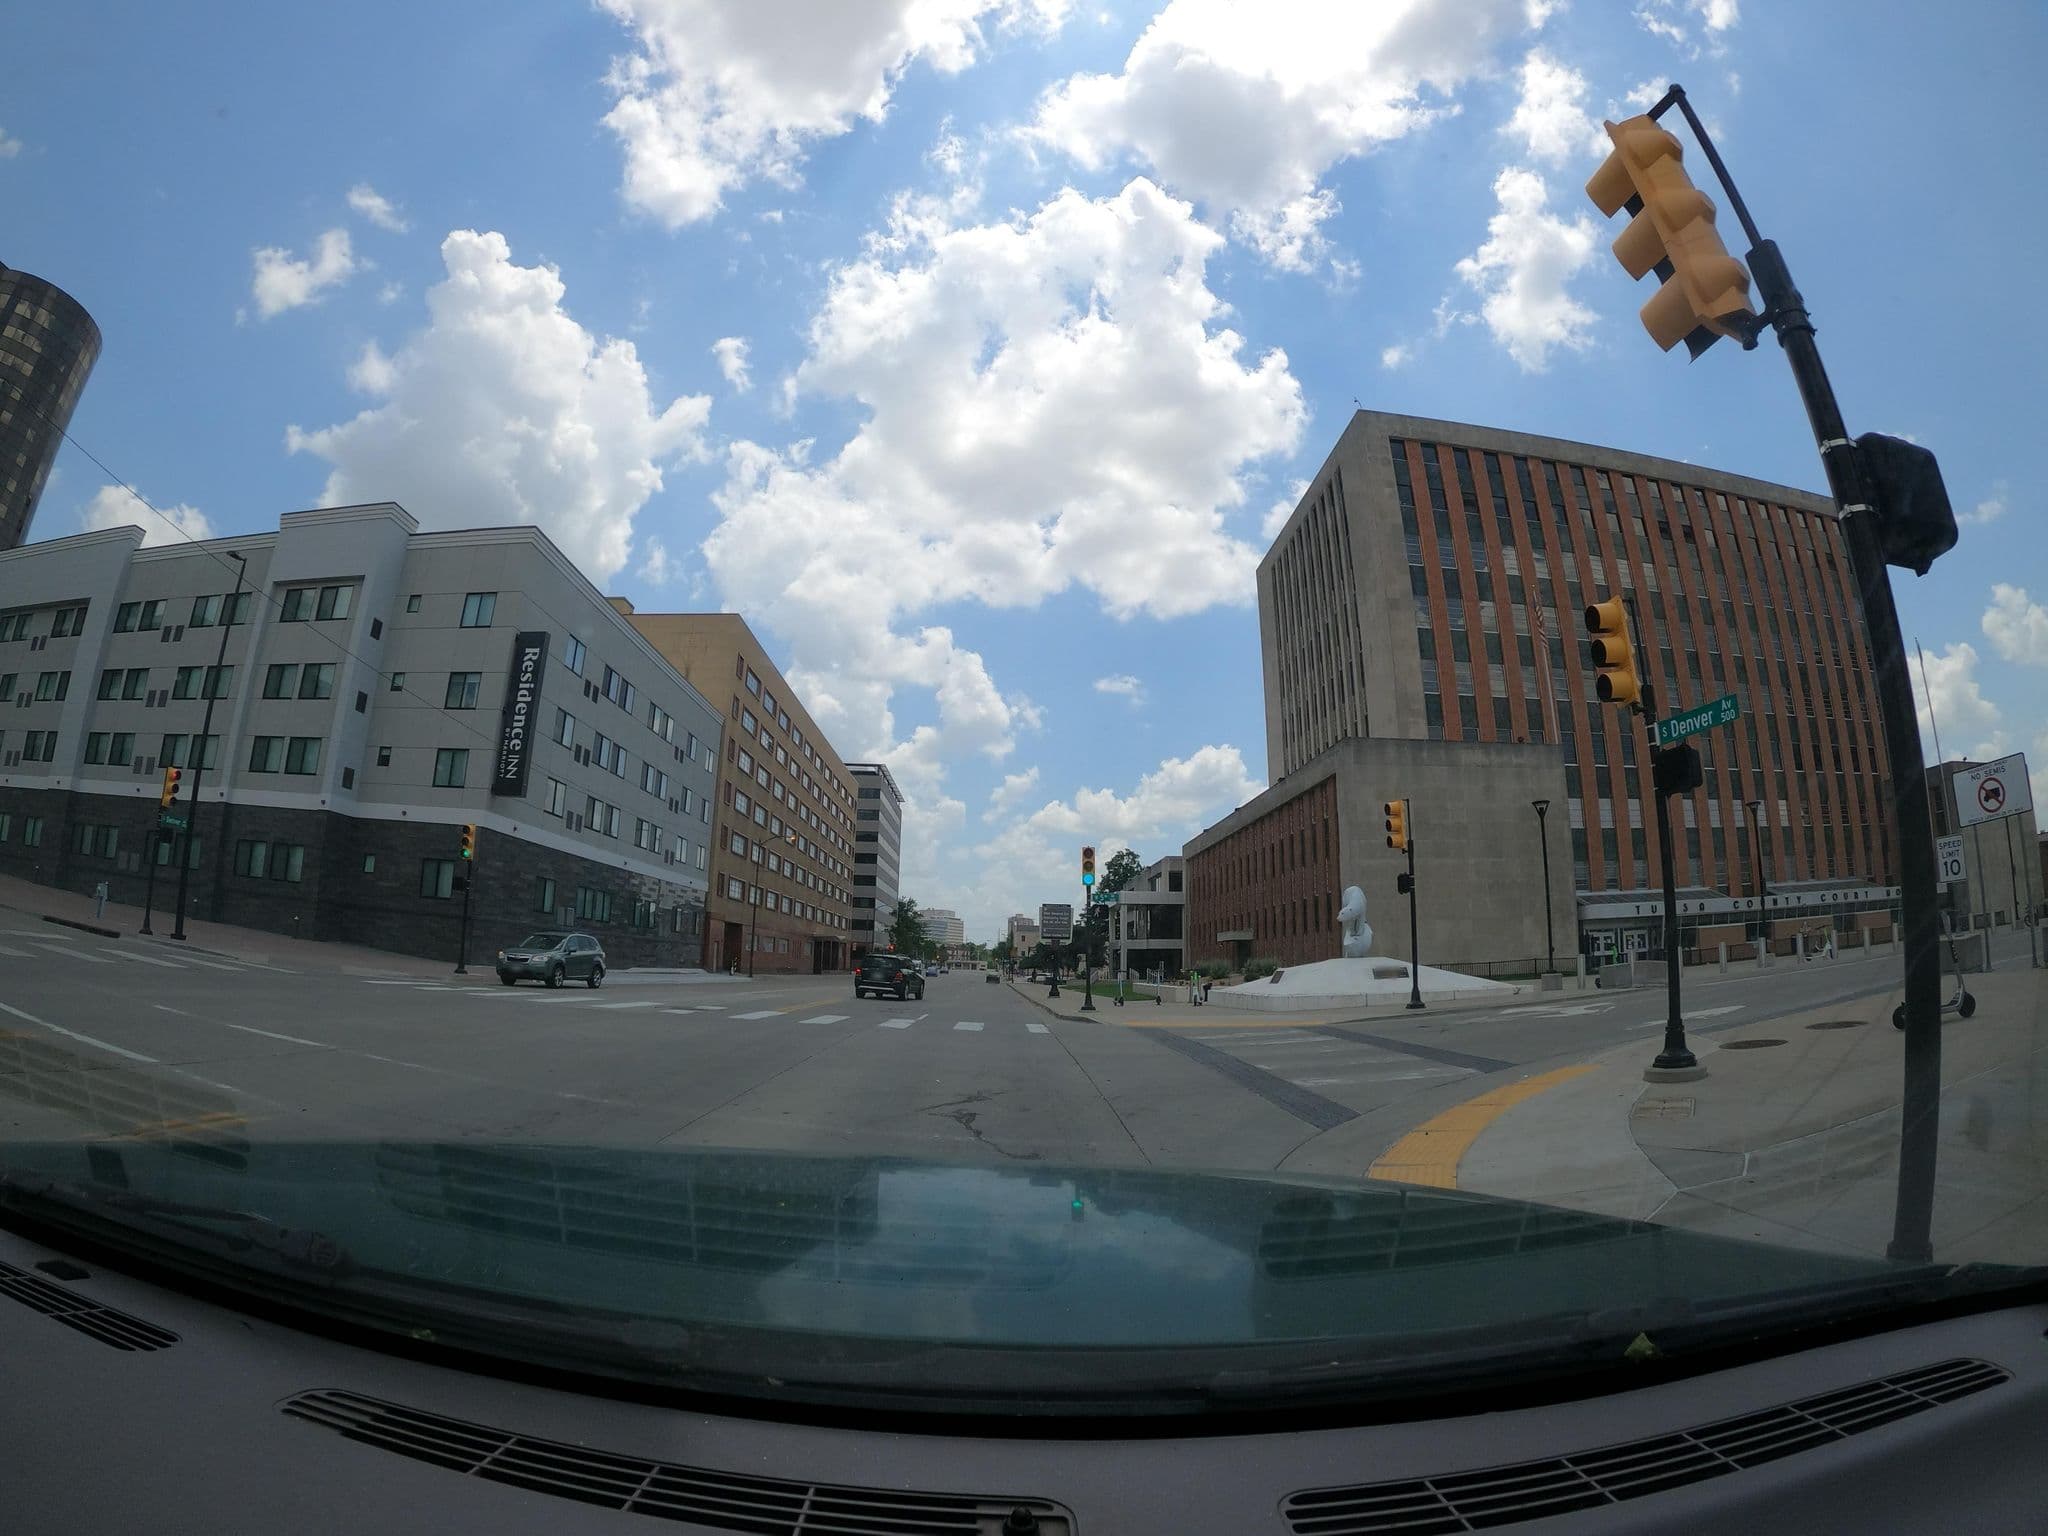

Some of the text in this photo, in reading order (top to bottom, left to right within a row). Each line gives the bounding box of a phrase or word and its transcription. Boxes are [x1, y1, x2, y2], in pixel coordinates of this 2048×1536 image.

[505, 647, 540, 778] Residence INN
[1721, 699, 1732, 711] Av
[1662, 711, 1712, 737] S Denver
[1720, 709, 1736, 722] 500
[500, 739, 509, 778] MARRIOTT
[1970, 772, 1982, 782] NO
[1983, 765, 2007, 778] SEMIS
[1939, 839, 1962, 850] SPEED
[1941, 849, 1961, 859] LIMIT
[1943, 859, 1961, 877] 10
[1635, 890, 1869, 915] TUSA CONTY COURT
